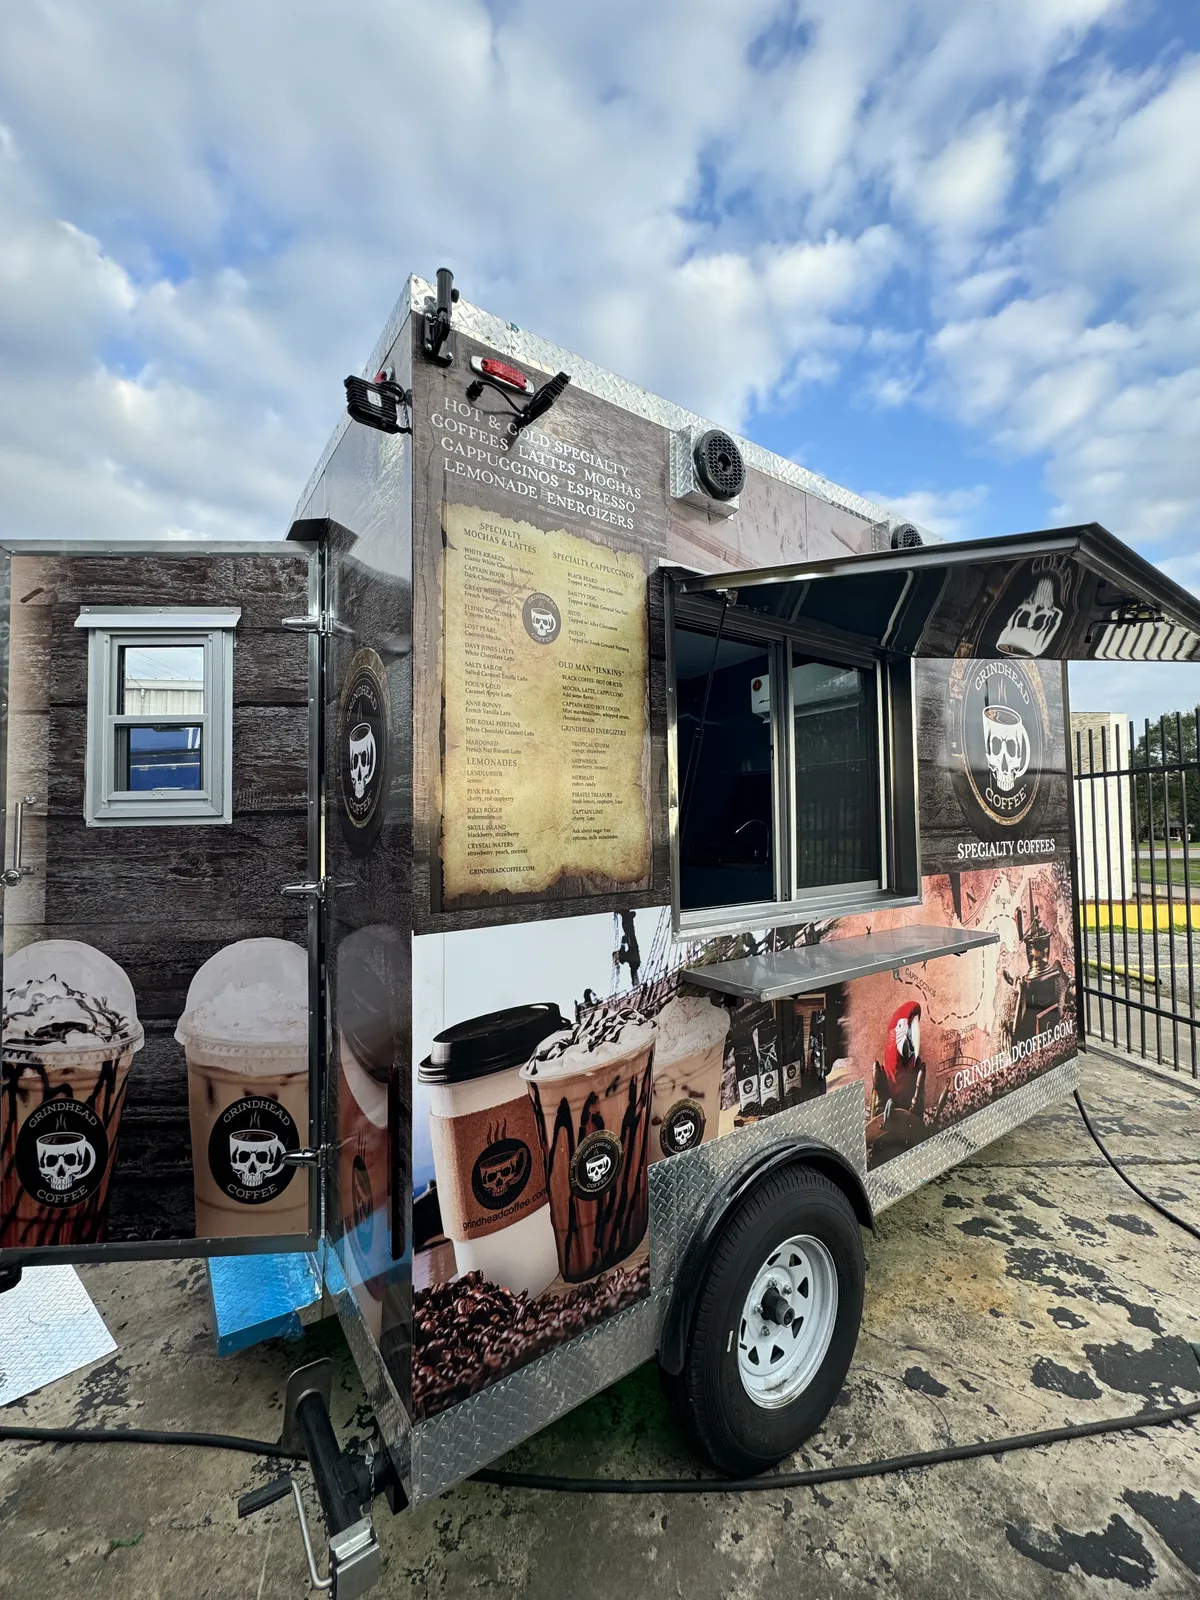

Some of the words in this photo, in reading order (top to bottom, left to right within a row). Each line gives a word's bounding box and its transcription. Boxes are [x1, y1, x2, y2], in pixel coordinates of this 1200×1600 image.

[444, 397, 483, 422] HOT
[489, 415, 501, 430] &
[507, 422, 549, 447] COLD
[555, 441, 628, 477] SPECIALTY
[431, 413, 509, 451] COFFEES
[519, 445, 576, 475] LATTES
[584, 469, 641, 499] MOCHAS
[441, 437, 559, 487] CAPPUCCINOS
[567, 480, 635, 513] ESPRESSO
[444, 457, 538, 499] LEMONADE
[547, 491, 634, 529] ENERGIZERS
[480, 522, 521, 539] SPECIALTY
[464, 528, 500, 544] MOCHAS
[502, 538, 507, 546] &
[510, 540, 537, 554] LATTES
[464, 547, 482, 556] WHITE
[483, 552, 505, 562] KRAKEN
[464, 554, 480, 563] Classic
[482, 558, 496, 567] White
[497, 562, 518, 572] Chocolate
[464, 564, 488, 574] CAPTAIN
[490, 570, 506, 578] HOOK
[552, 552, 588, 567] SPECIALTY
[590, 562, 634, 580] CAPPUCCINOS
[464, 584, 482, 592] GREAT
[484, 588, 500, 596] WHITE
[464, 604, 484, 613] FLYING
[485, 608, 516, 619] DUTCHMAN
[464, 623, 479, 631] LOST
[480, 626, 496, 634] PEARL
[480, 644, 498, 652] JONES
[498, 647, 514, 655] LATTE
[480, 652, 503, 660] Chocolate
[482, 664, 502, 672] SAILOR
[558, 660, 574, 668] OLD
[575, 663, 591, 672] MAN
[975, 662, 1030, 705] GRINDHEAD
[596, 690, 624, 698] CAPPUCCINO
[346, 684, 378, 722] GRINDHEAD
[561, 725, 596, 734] GRINDHEAD
[596, 728, 626, 736] ENERGIZERS
[466, 758, 518, 767] LEMONADES
[350, 796, 372, 815] COFFEE
[985, 785, 1026, 810] COFFEE
[957, 840, 1014, 860] SPECIALTY
[1018, 838, 1056, 855] COFFEES
[469, 866, 535, 876] GRINDHEADCOFFEE.COM
[904, 968, 936, 998] CAPPUCCINOS
[954, 1020, 1074, 1092] GRINDHEADCOFFEE.COM
[28, 1102, 98, 1128] GRINDHEAD
[223, 1100, 290, 1126] GRINDHEAD
[582, 1142, 612, 1158] GRINDHEAD
[586, 1176, 608, 1188] COFFEE
[36, 1184, 88, 1204] COFFEE
[227, 1184, 278, 1200] COFFEE
